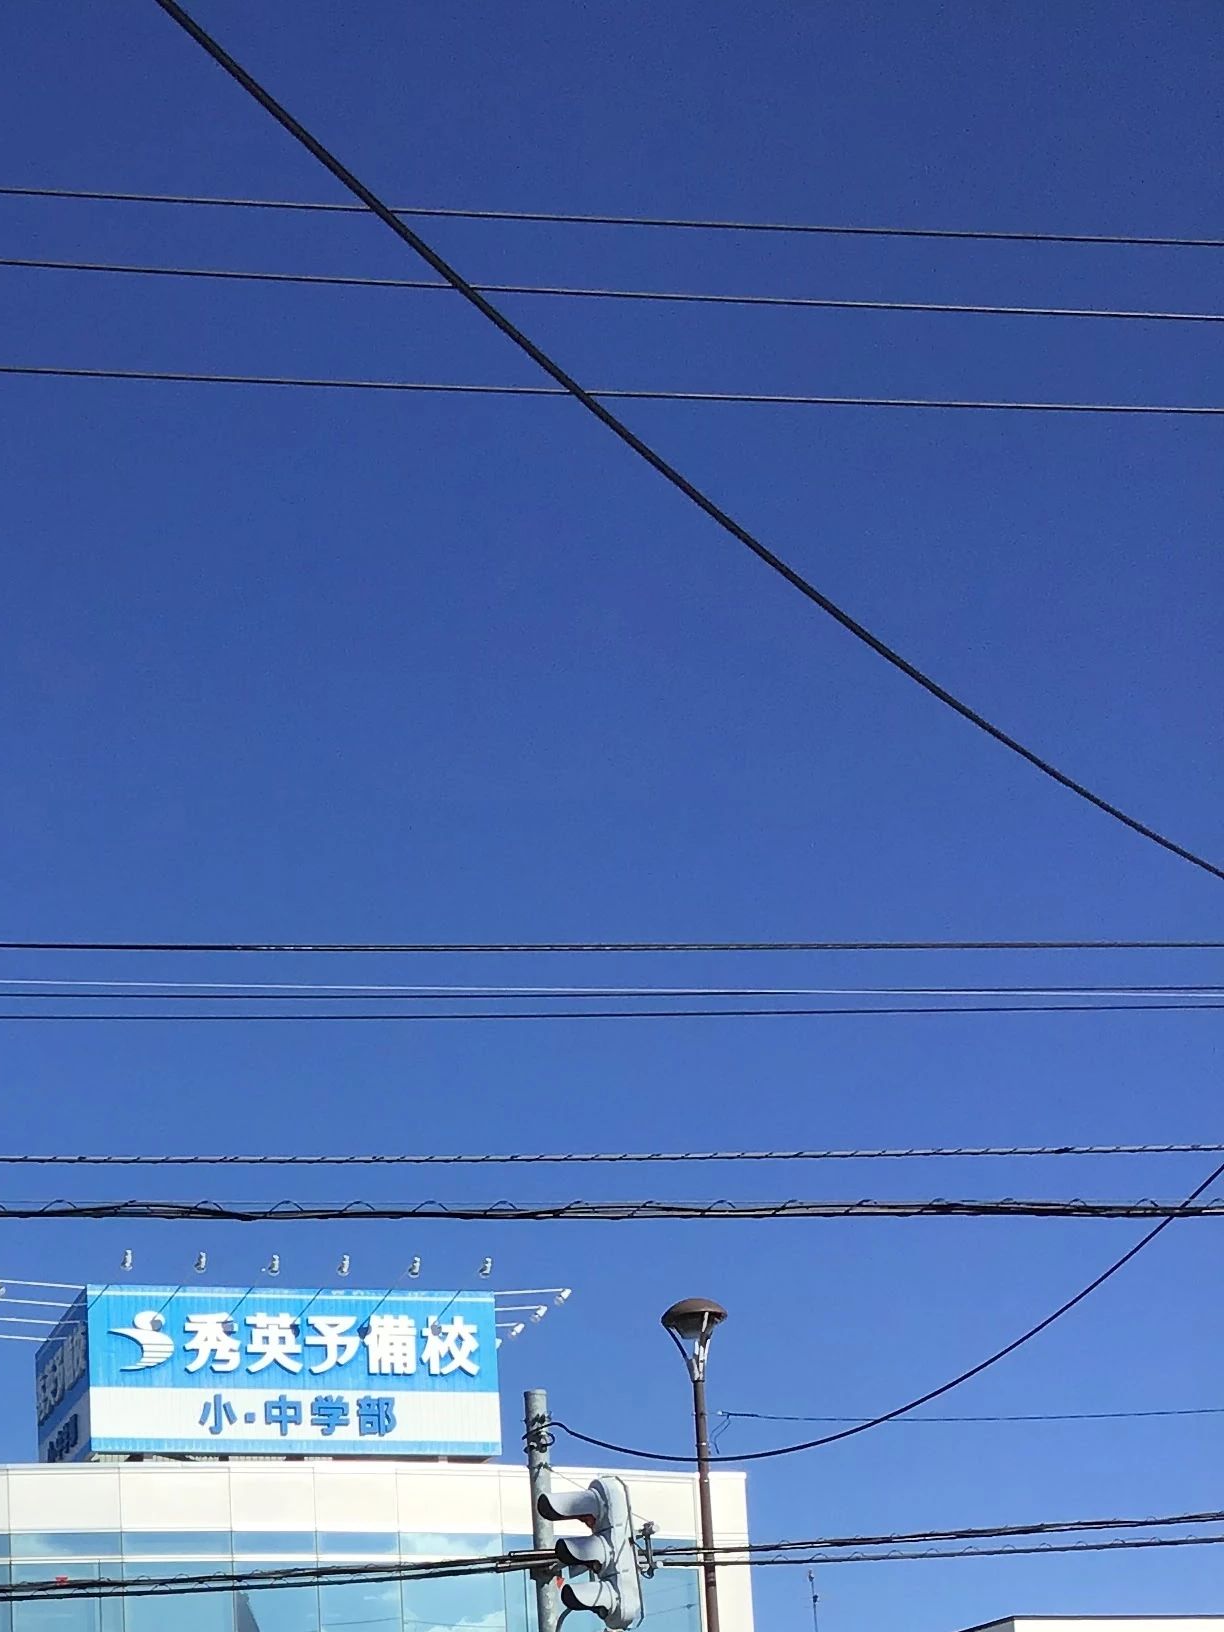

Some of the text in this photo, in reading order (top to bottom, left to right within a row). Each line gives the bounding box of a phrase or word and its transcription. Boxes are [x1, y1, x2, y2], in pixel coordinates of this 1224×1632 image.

[184, 1311, 480, 1377] 秀英予備校
